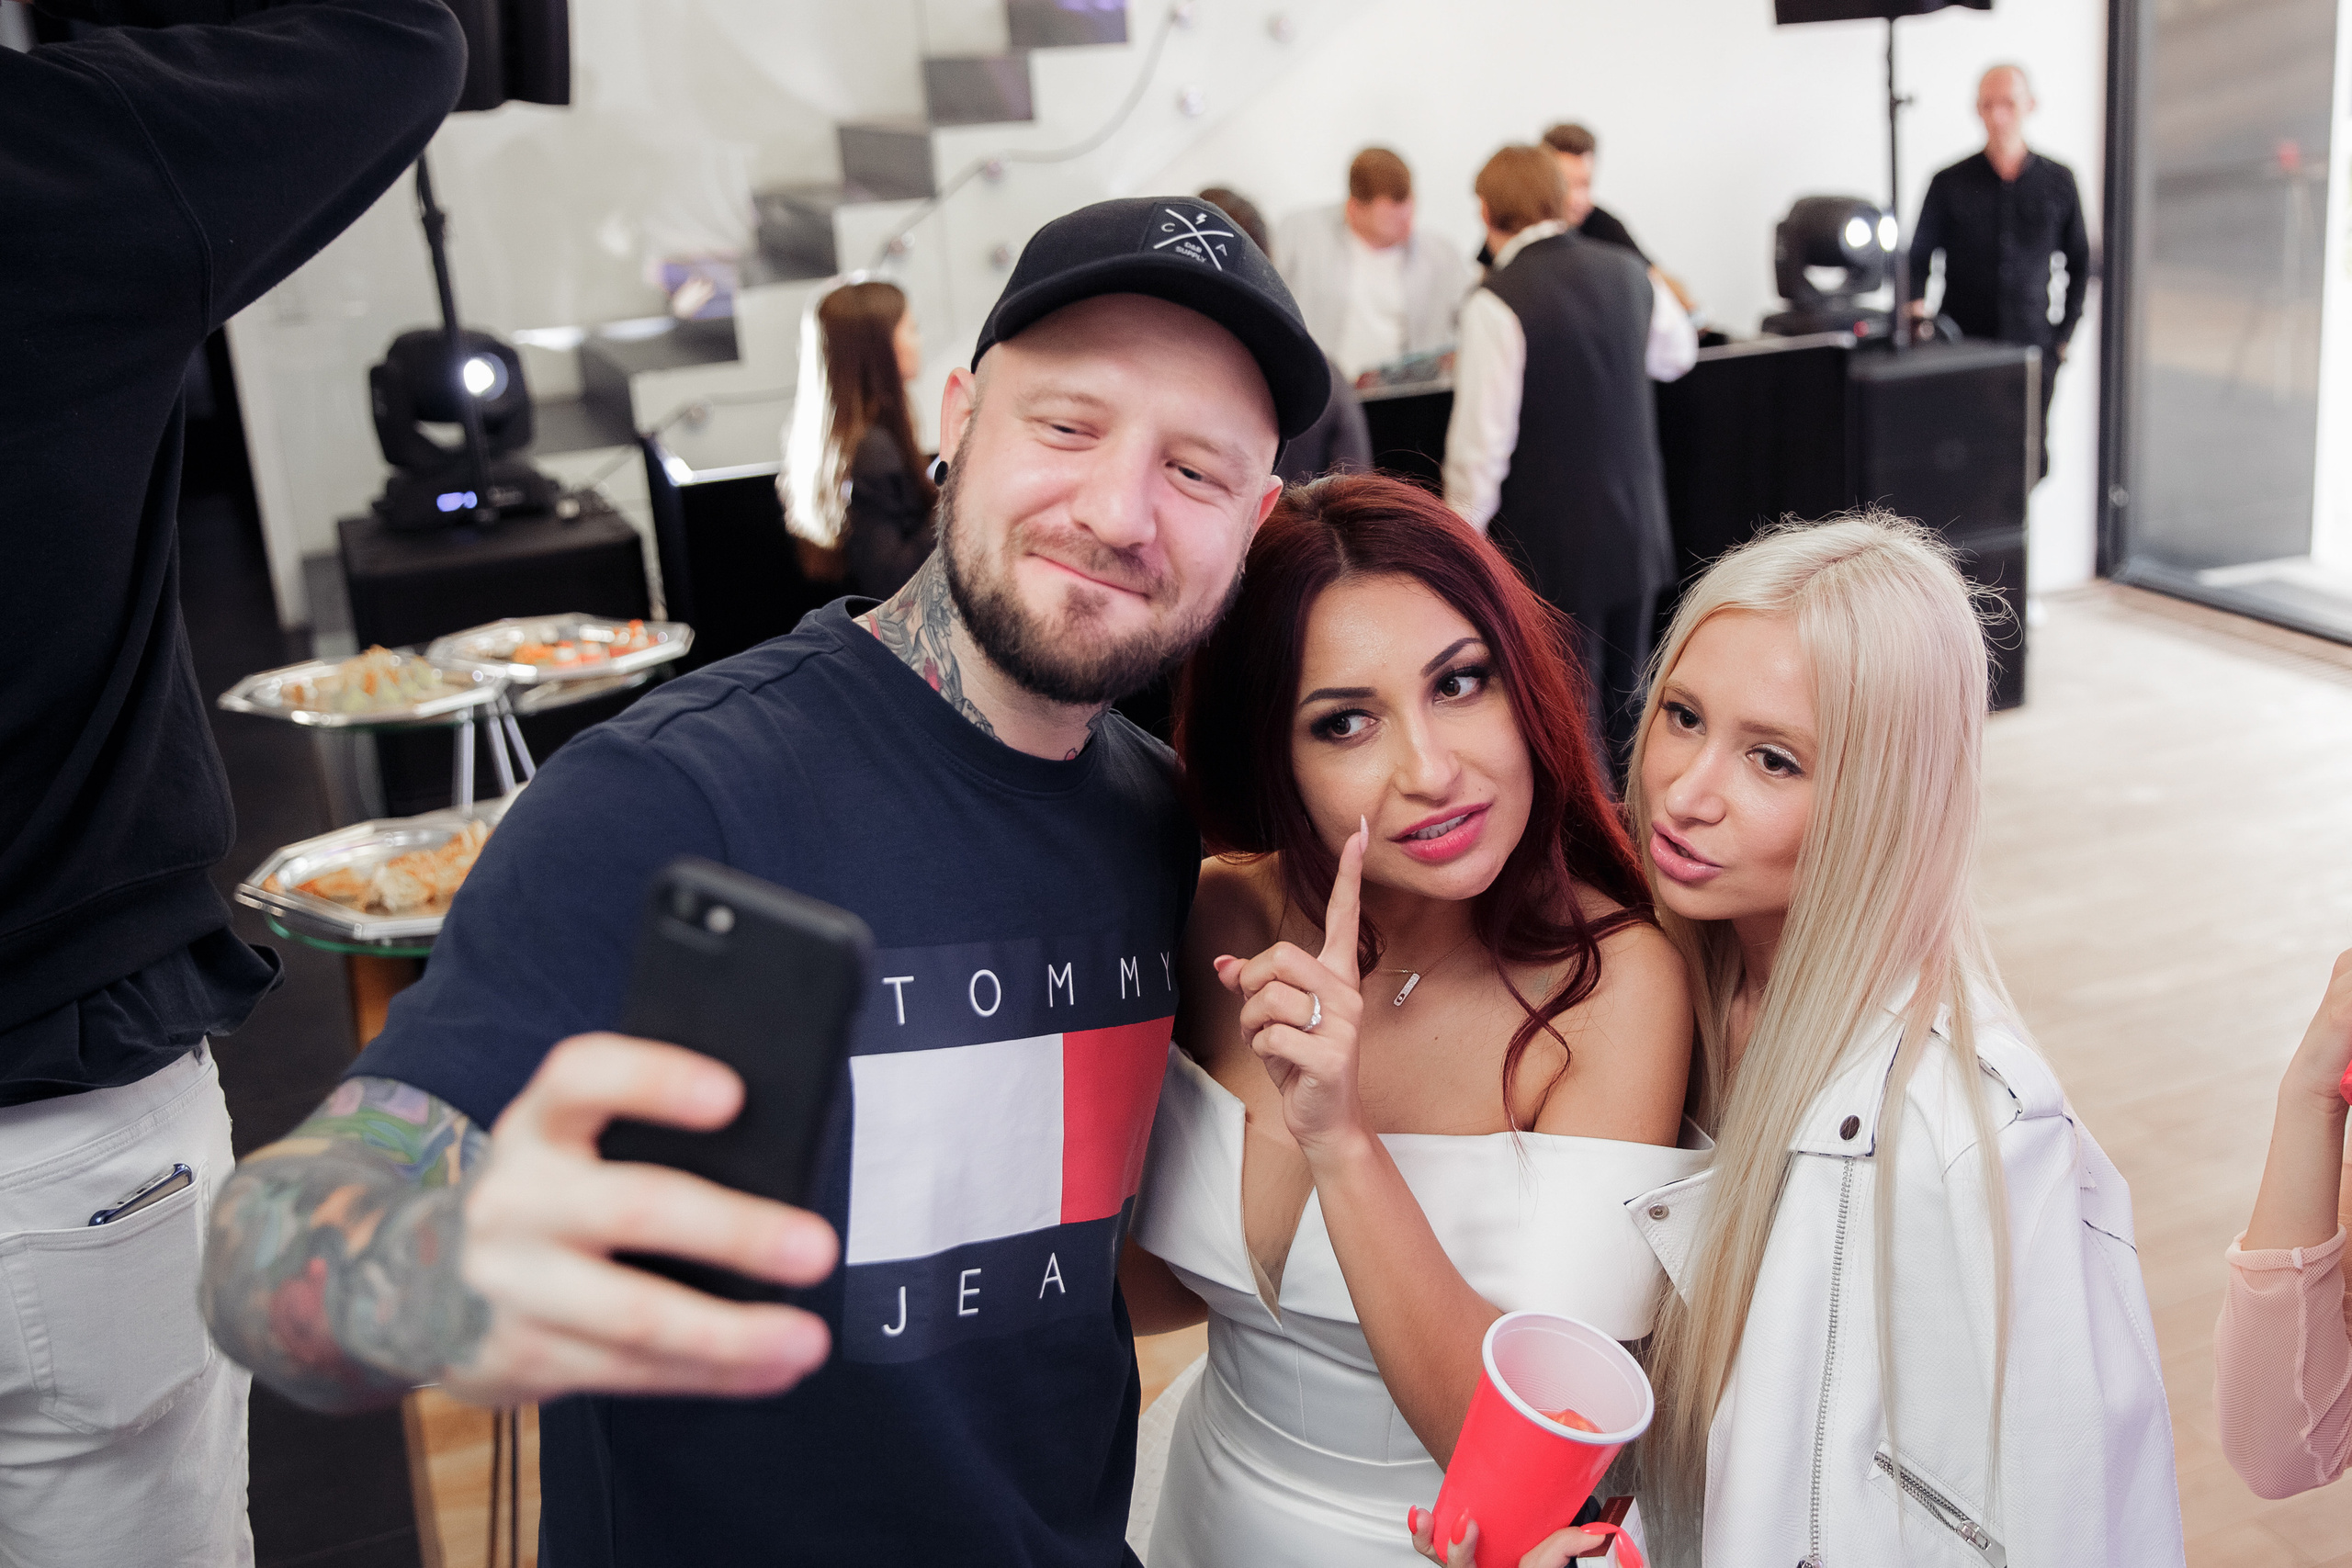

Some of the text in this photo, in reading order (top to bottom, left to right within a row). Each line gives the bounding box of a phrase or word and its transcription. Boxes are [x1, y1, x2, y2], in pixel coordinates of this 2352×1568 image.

[1160, 222, 1227, 256] C A
[1175, 245, 1206, 263] SUPPLY
[882, 951, 1171, 1025] TOMMY
[882, 1232, 1117, 1337] JEA
